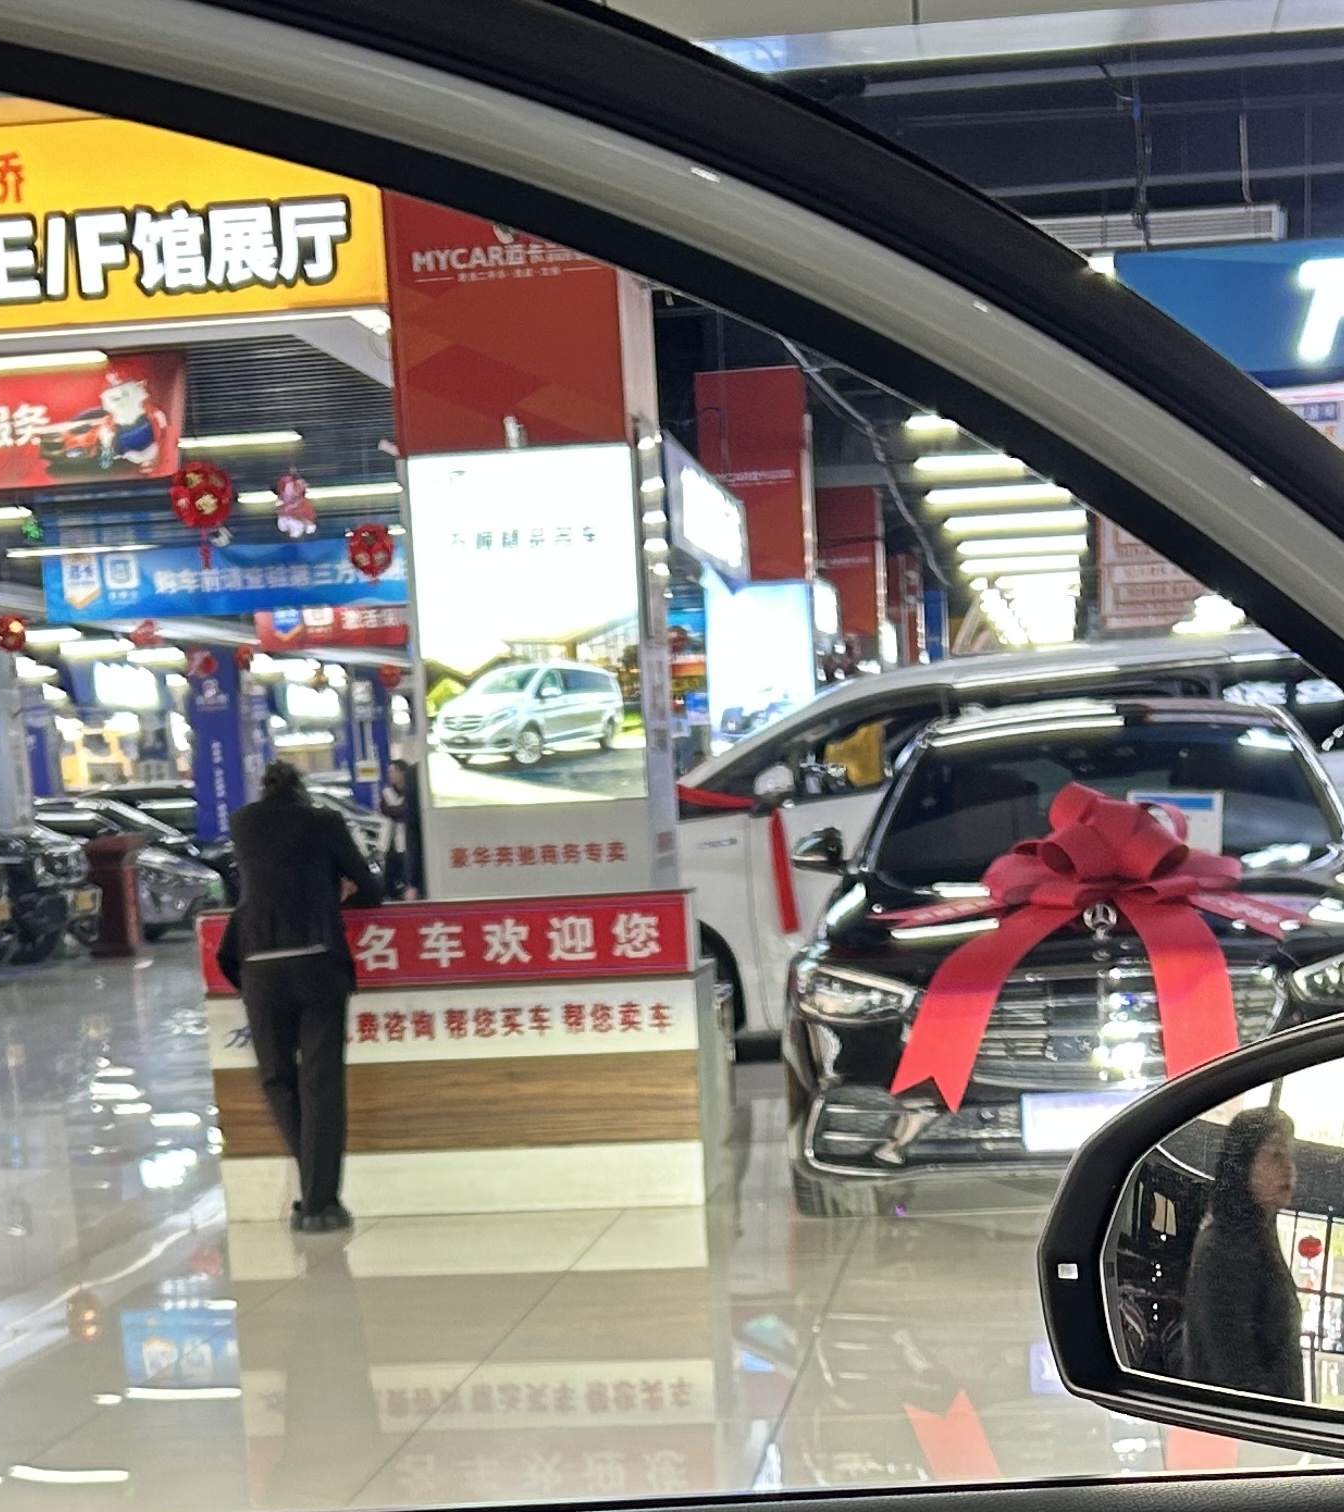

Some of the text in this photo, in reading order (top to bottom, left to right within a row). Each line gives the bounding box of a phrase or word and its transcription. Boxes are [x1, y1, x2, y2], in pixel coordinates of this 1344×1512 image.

[449, 840, 628, 870] 豪华奔驰商务专卖
[444, 1005, 553, 1039] 帮您买车
[562, 1001, 671, 1034] 帮您卖车
